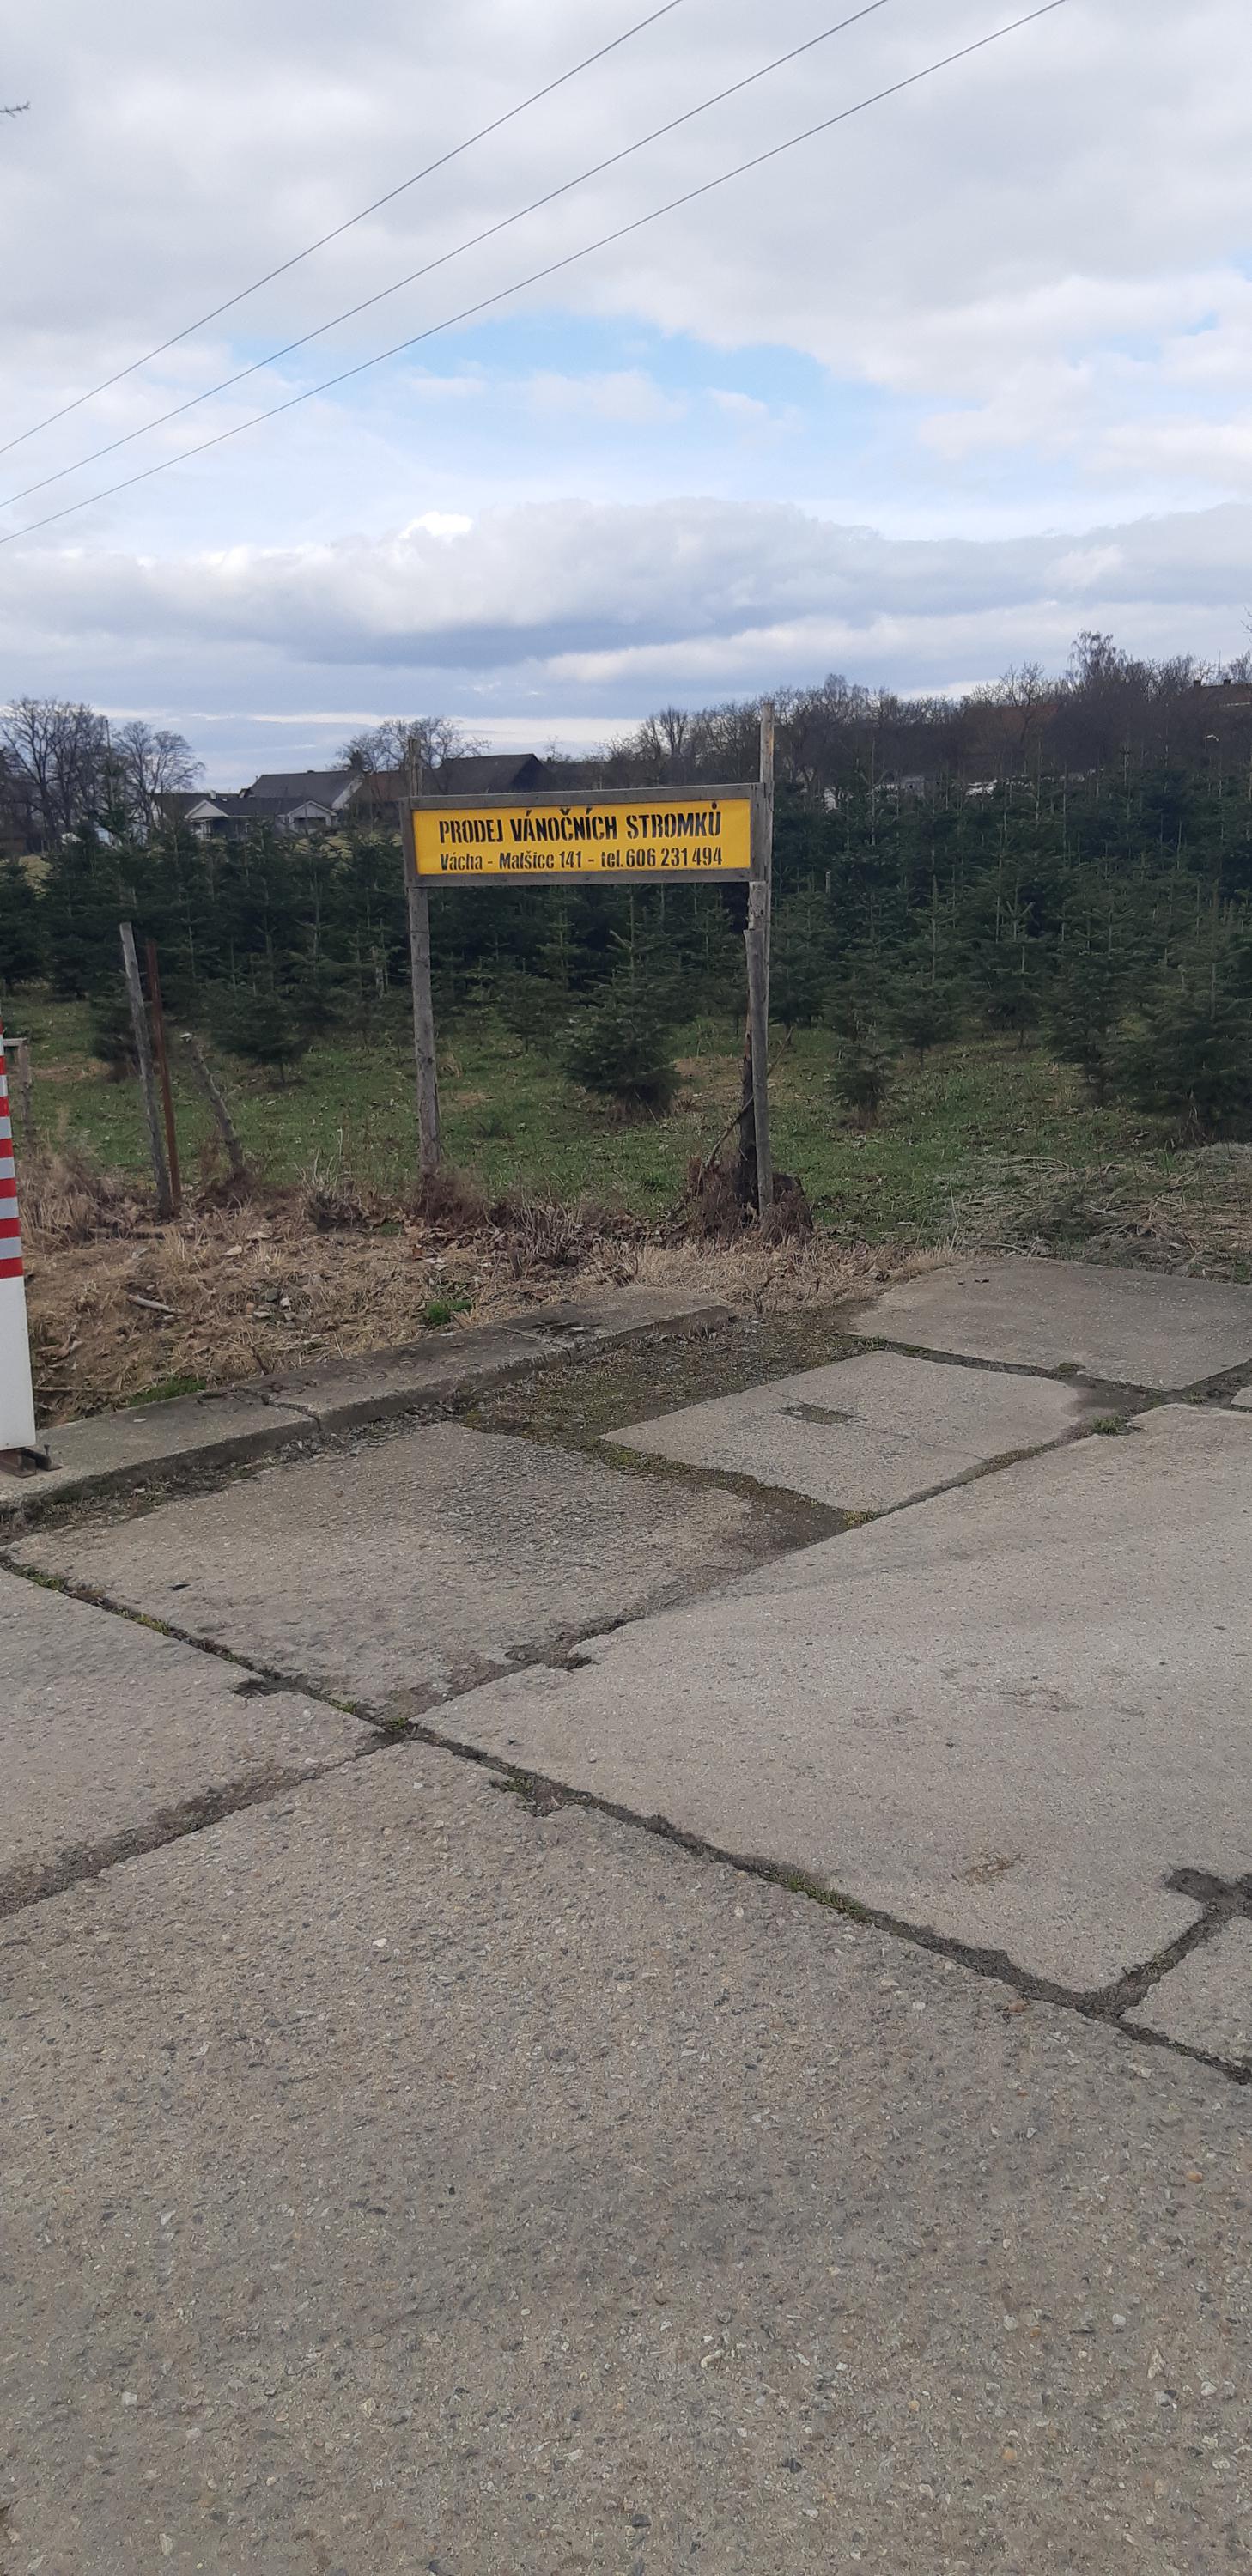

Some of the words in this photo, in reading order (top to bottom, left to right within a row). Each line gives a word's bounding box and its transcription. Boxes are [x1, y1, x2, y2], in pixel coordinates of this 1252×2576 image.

[439, 818, 503, 843] PRODEJ
[509, 807, 617, 842] VÁNOČNÍCH
[626, 802, 721, 839] STROMKŮ
[440, 851, 483, 871] Vácha
[499, 850, 554, 869] Malšice
[559, 850, 582, 868] 141
[660, 847, 688, 867] 231
[691, 846, 723, 866] 494
